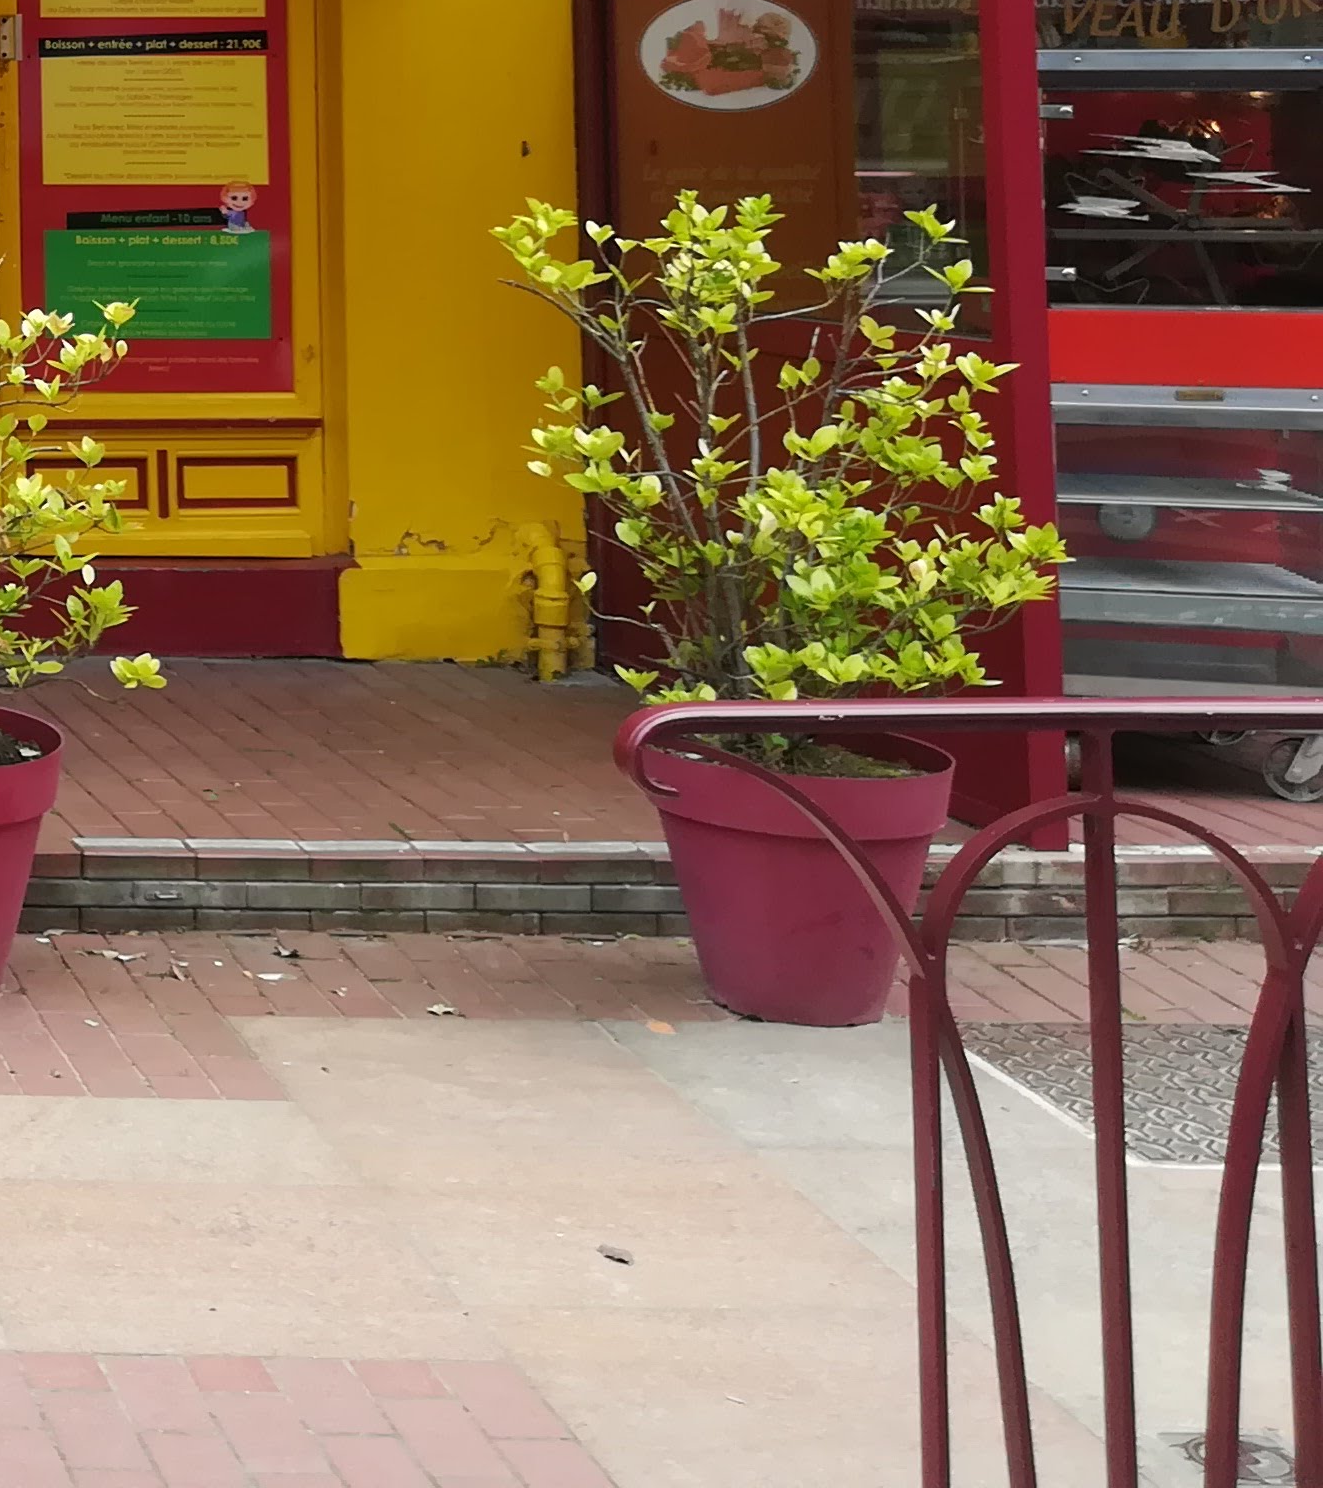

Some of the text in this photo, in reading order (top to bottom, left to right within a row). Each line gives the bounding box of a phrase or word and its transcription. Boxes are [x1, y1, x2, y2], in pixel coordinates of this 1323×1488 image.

[45, 39, 86, 50] Boisson
[97, 37, 133, 50] entrée
[145, 38, 167, 51] plat
[178, 38, 219, 50] dessert
[101, 213, 133, 224] Menu
[75, 235, 116, 246] Boisson
[128, 235, 150, 247] plat
[162, 235, 202, 246] dessert
